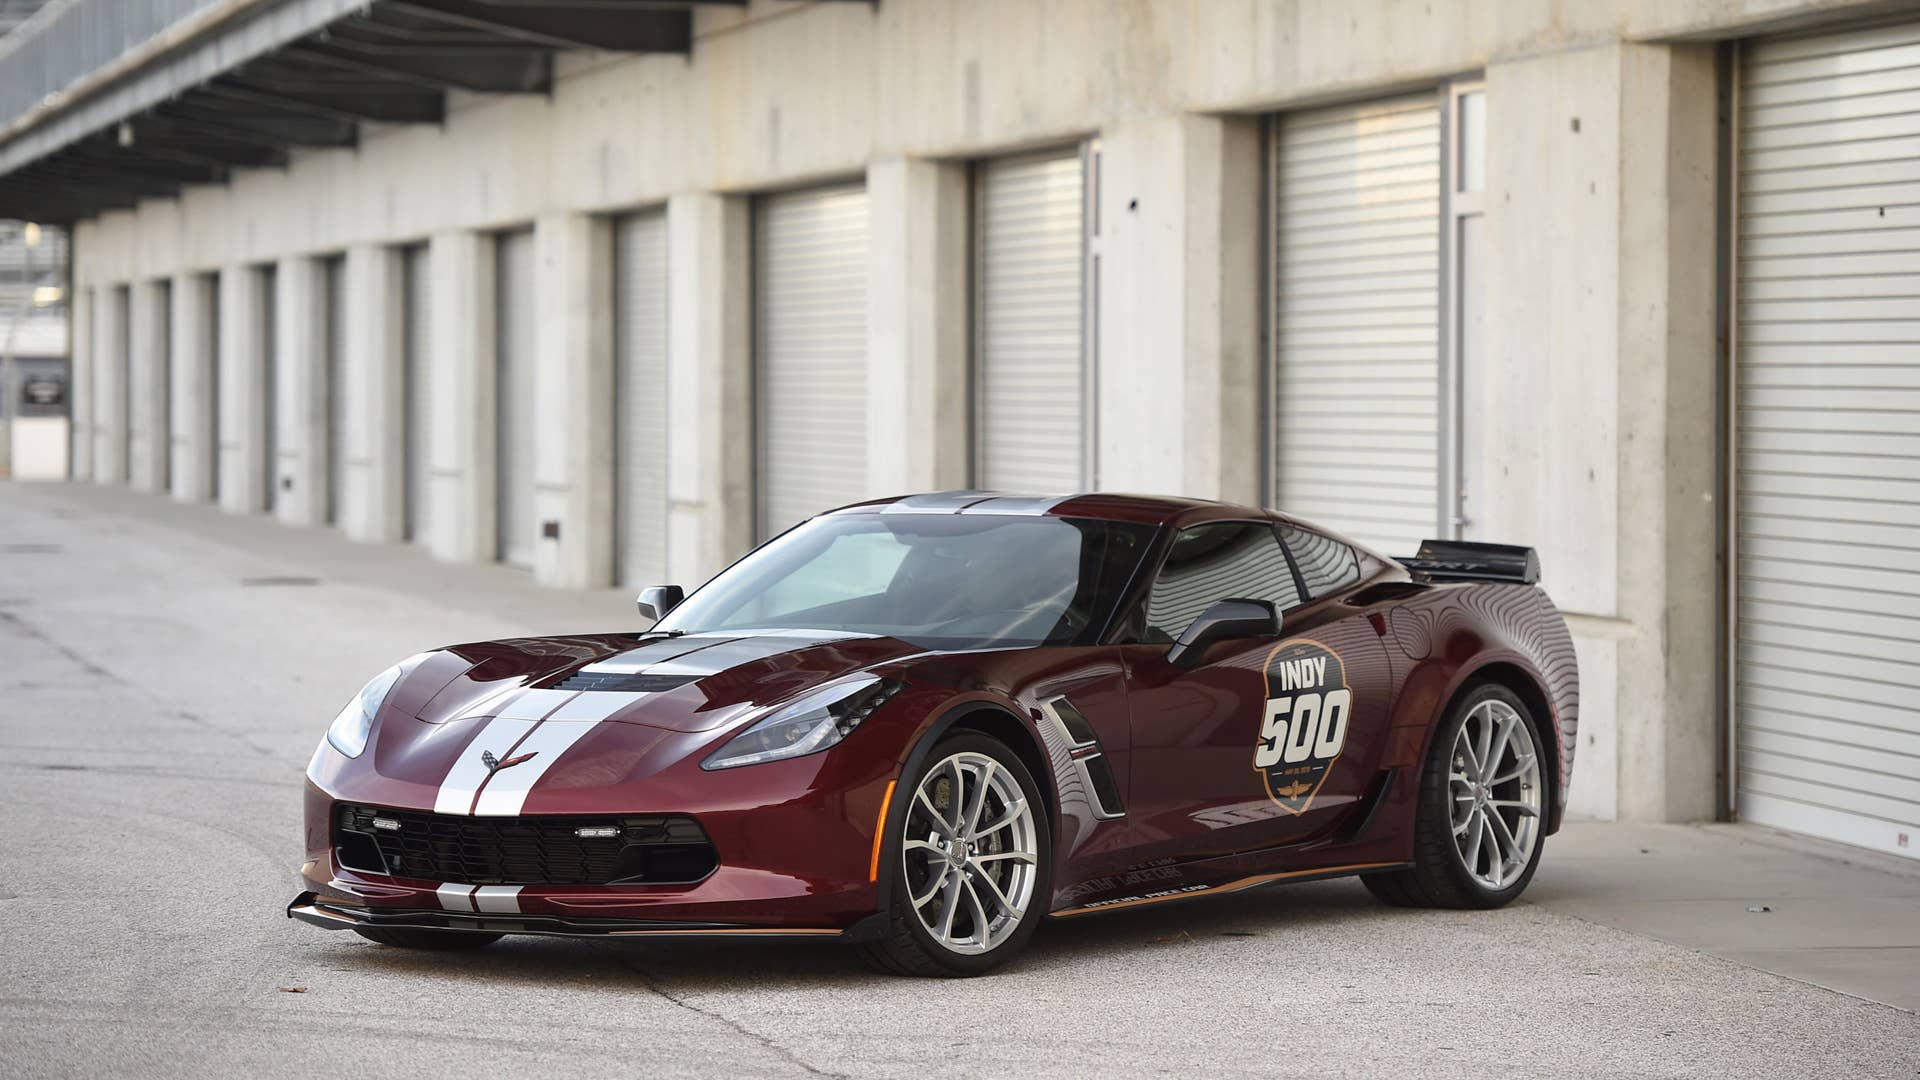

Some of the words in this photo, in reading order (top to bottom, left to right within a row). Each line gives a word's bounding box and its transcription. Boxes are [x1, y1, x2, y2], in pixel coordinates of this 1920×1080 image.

[1280, 657, 1326, 691] INDY
[1255, 689, 1351, 768] 500
[1182, 884, 1210, 892] CAR
